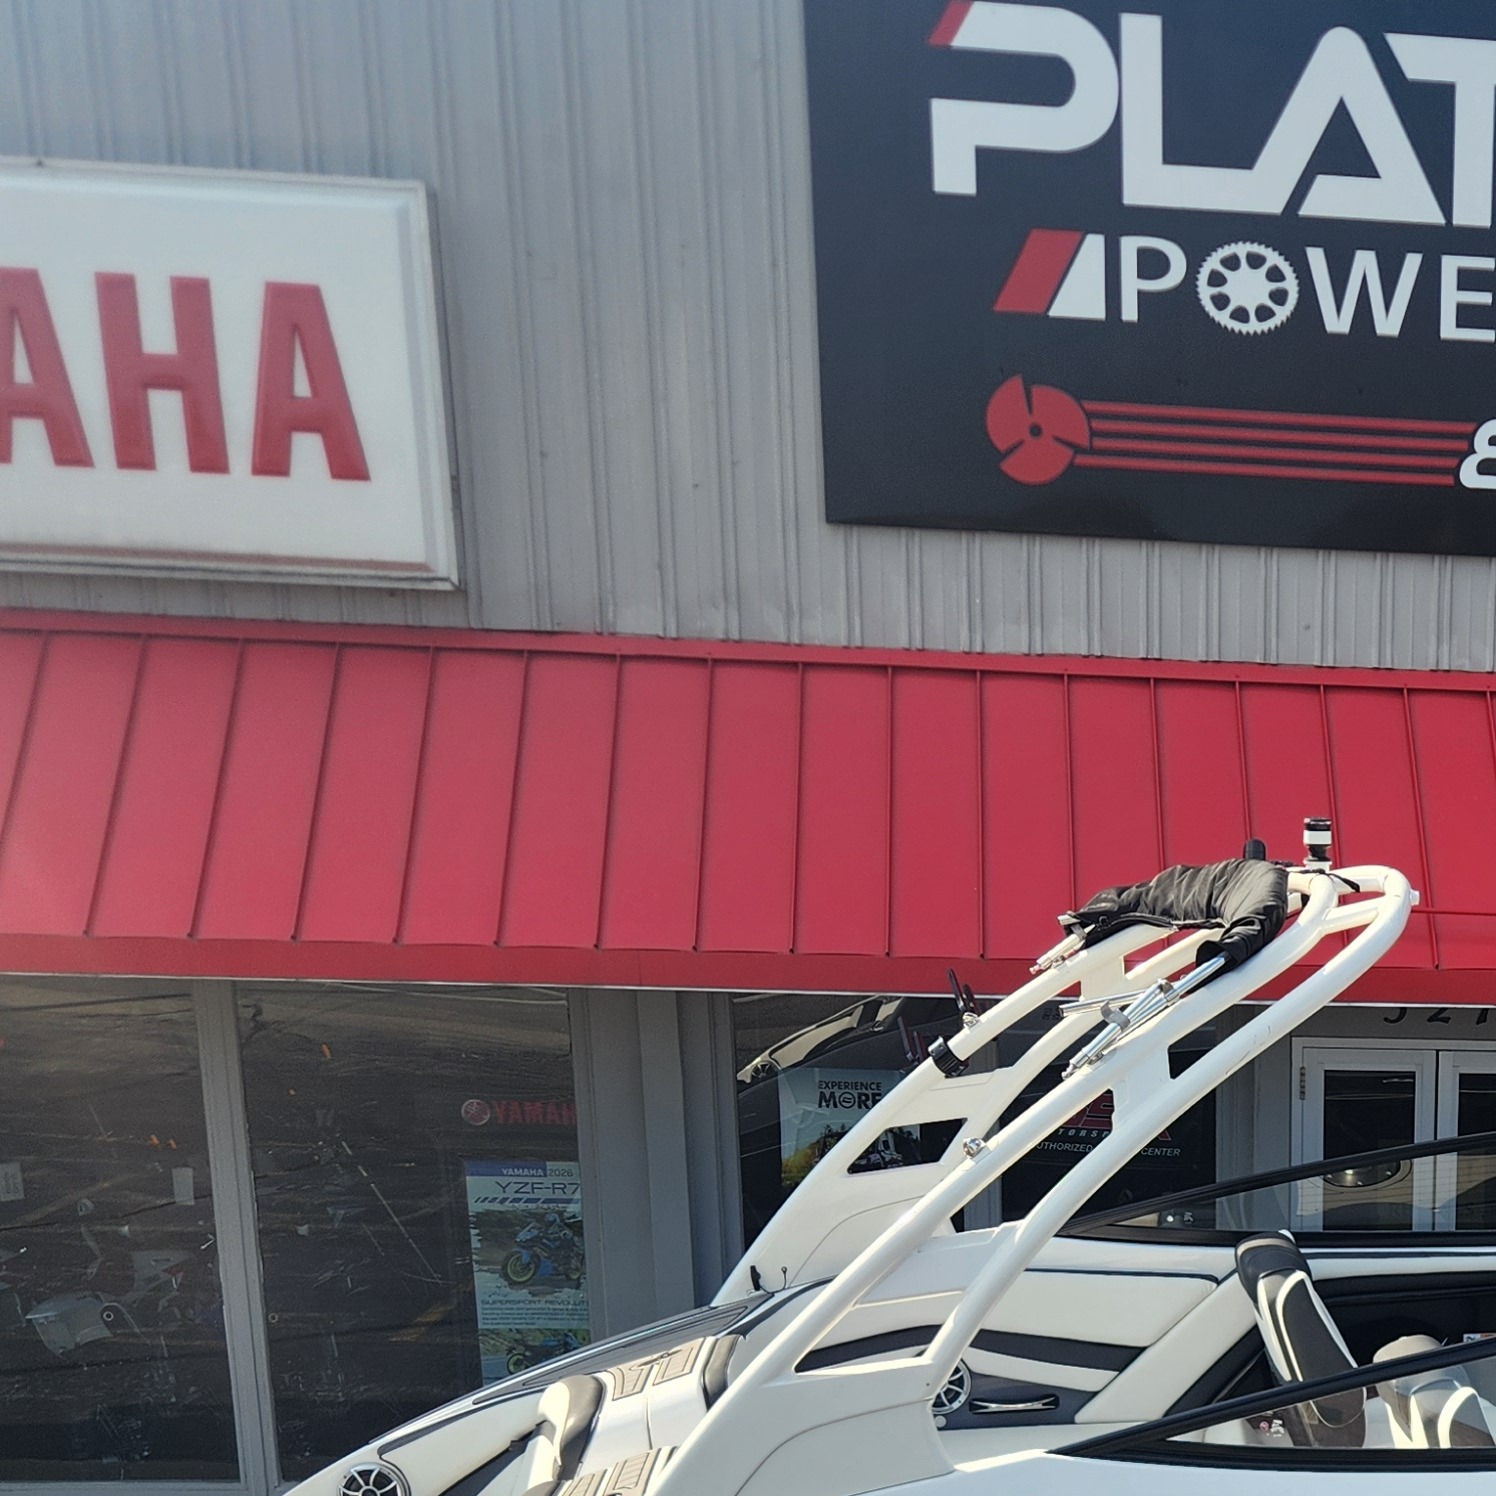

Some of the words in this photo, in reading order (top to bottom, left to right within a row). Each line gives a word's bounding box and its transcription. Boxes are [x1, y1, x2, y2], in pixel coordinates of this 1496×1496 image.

[0, 266, 371, 482] AHA
[818, 1080, 882, 1091] EXPERIENCE
[817, 1091, 883, 1110] MORE
[493, 1101, 577, 1125] YAMAH
[1037, 1141, 1093, 1153] UTHORIZED
[1141, 1147, 1181, 1157] CENTER
[501, 1168, 544, 1177] YAMAHA
[494, 1181, 581, 1195] YZF-R7
